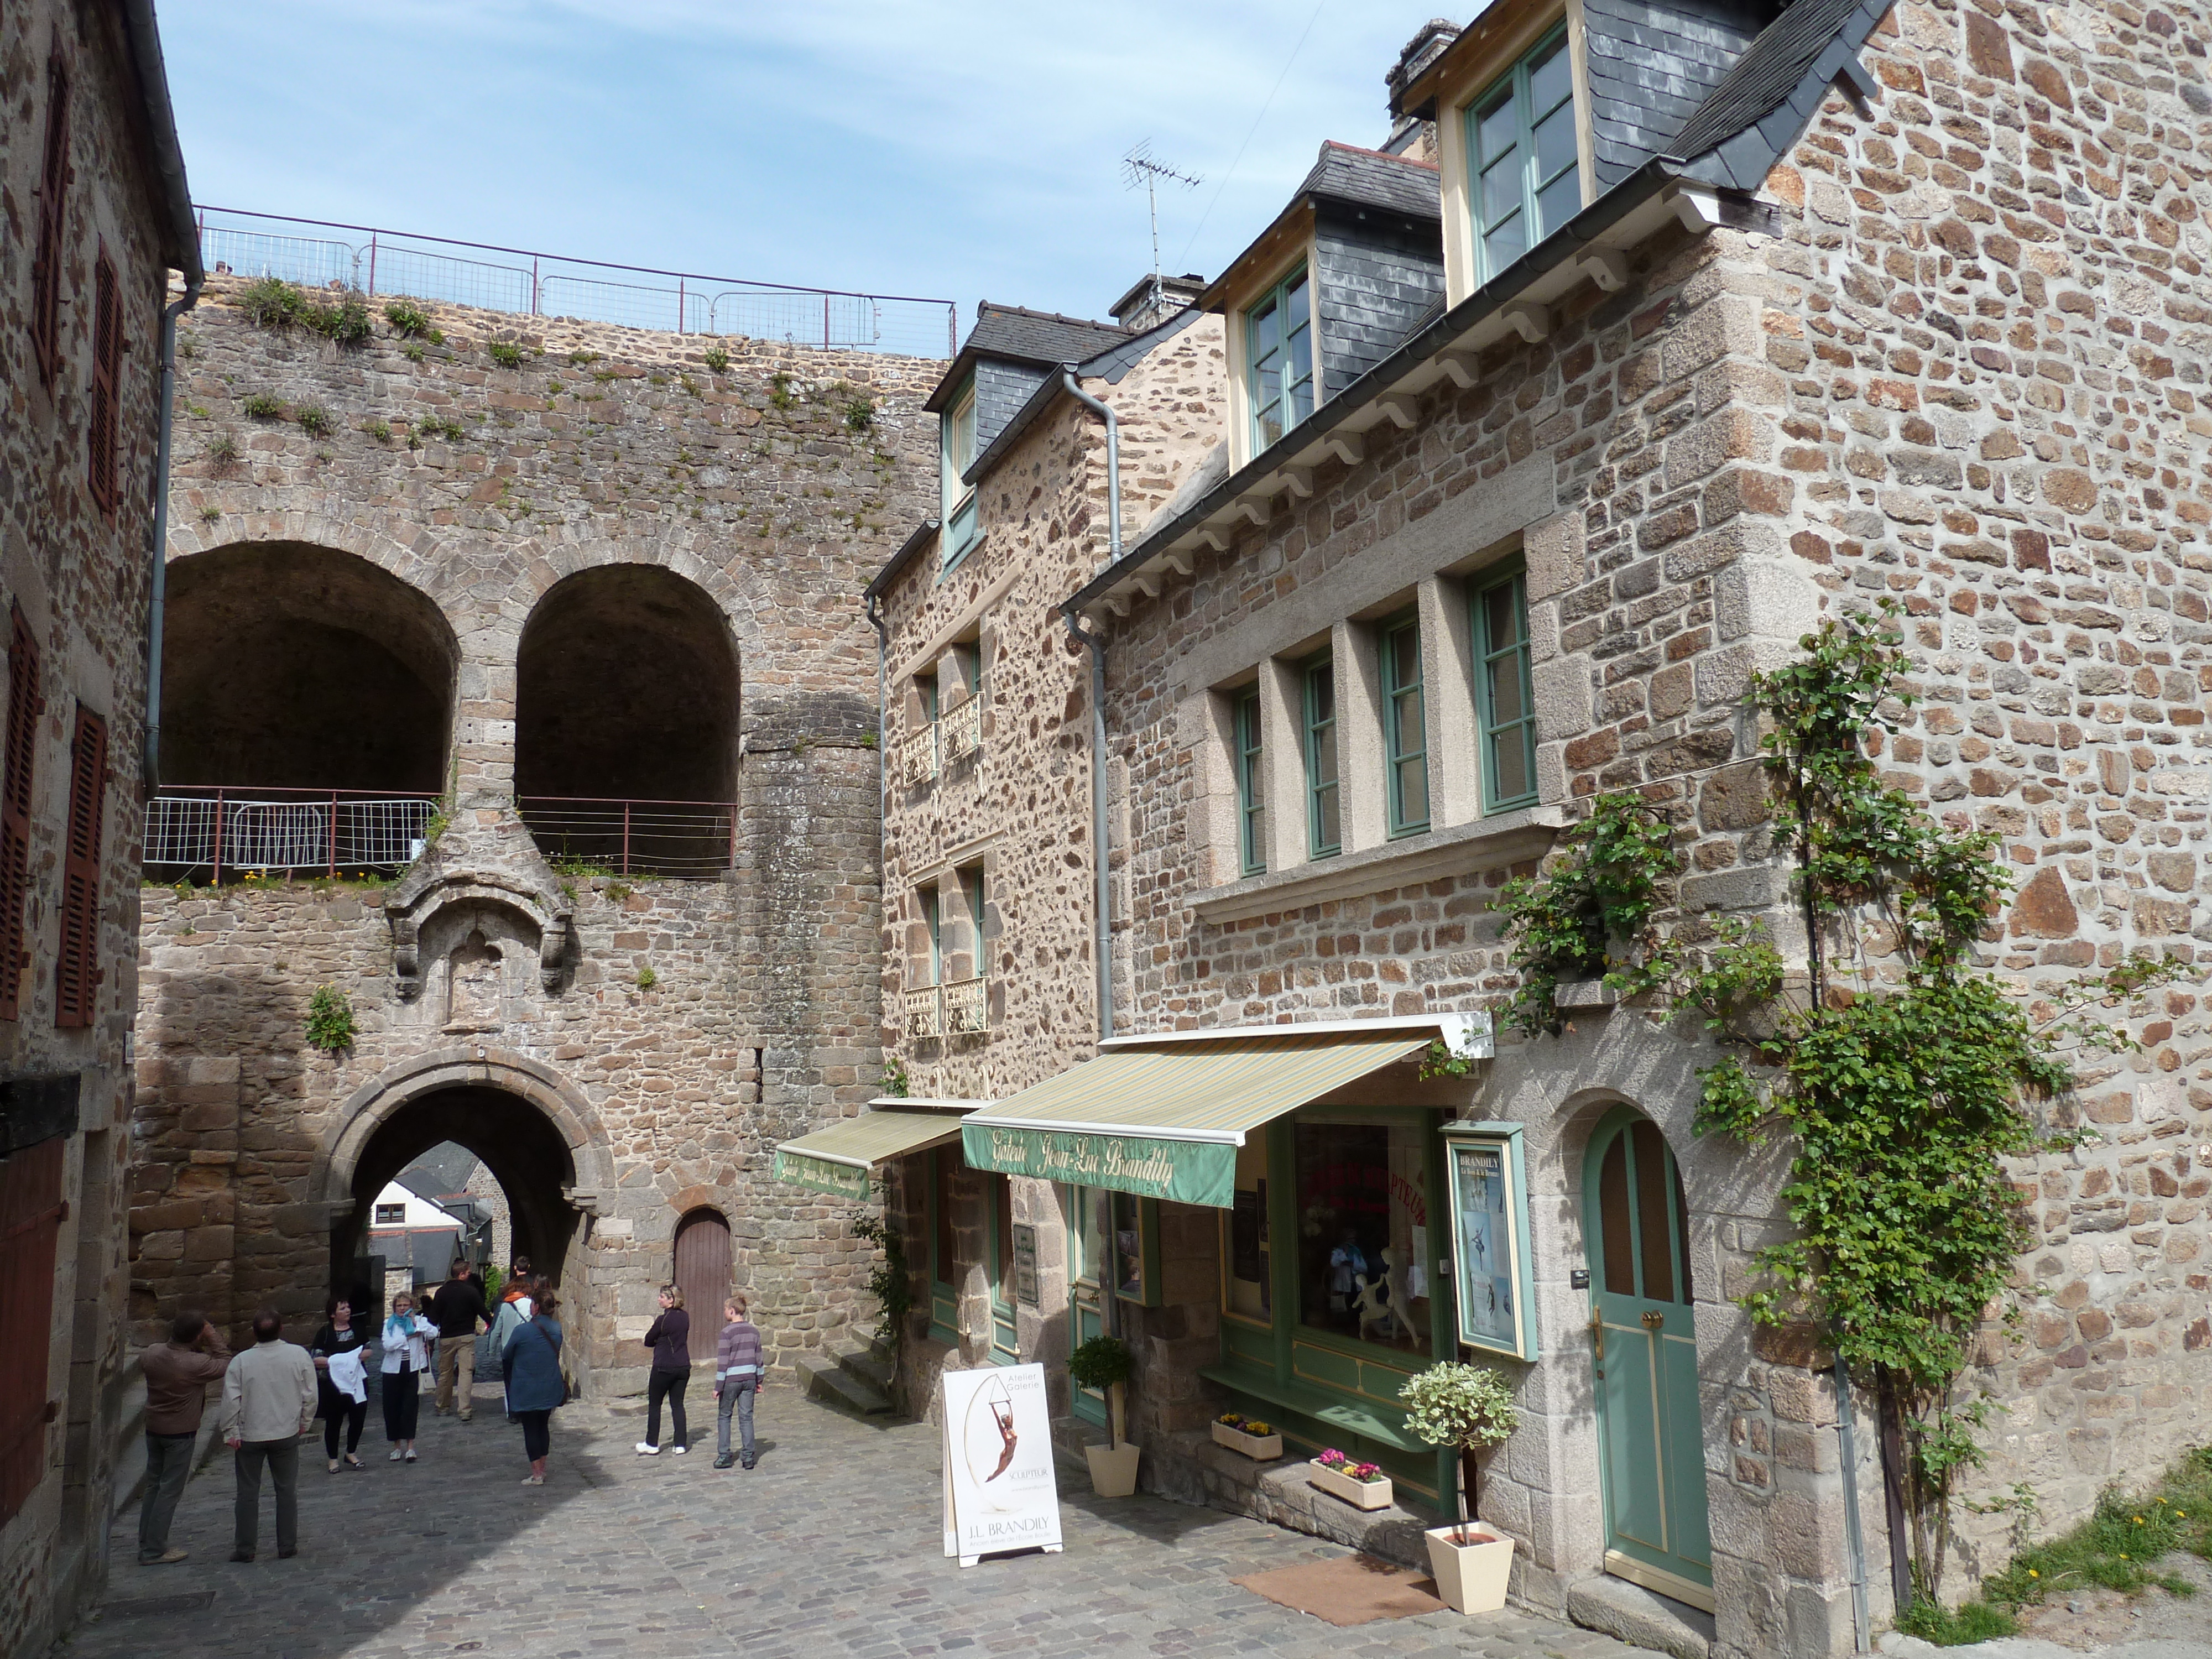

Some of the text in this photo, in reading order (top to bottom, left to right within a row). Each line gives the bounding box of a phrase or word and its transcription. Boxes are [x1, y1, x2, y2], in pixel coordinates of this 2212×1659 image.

[1037, 1134, 1099, 1173] Jean-Luc
[1103, 1139, 1173, 1194] Brandily
[1460, 1155, 1498, 1168] BRANDILY
[1008, 1373, 1036, 1382] Atelier
[1006, 1382, 1039, 1391] Galerie
[1009, 1469, 1048, 1479] SCULPTEUR
[969, 1516, 1048, 1538] J.L. BRANDILY
